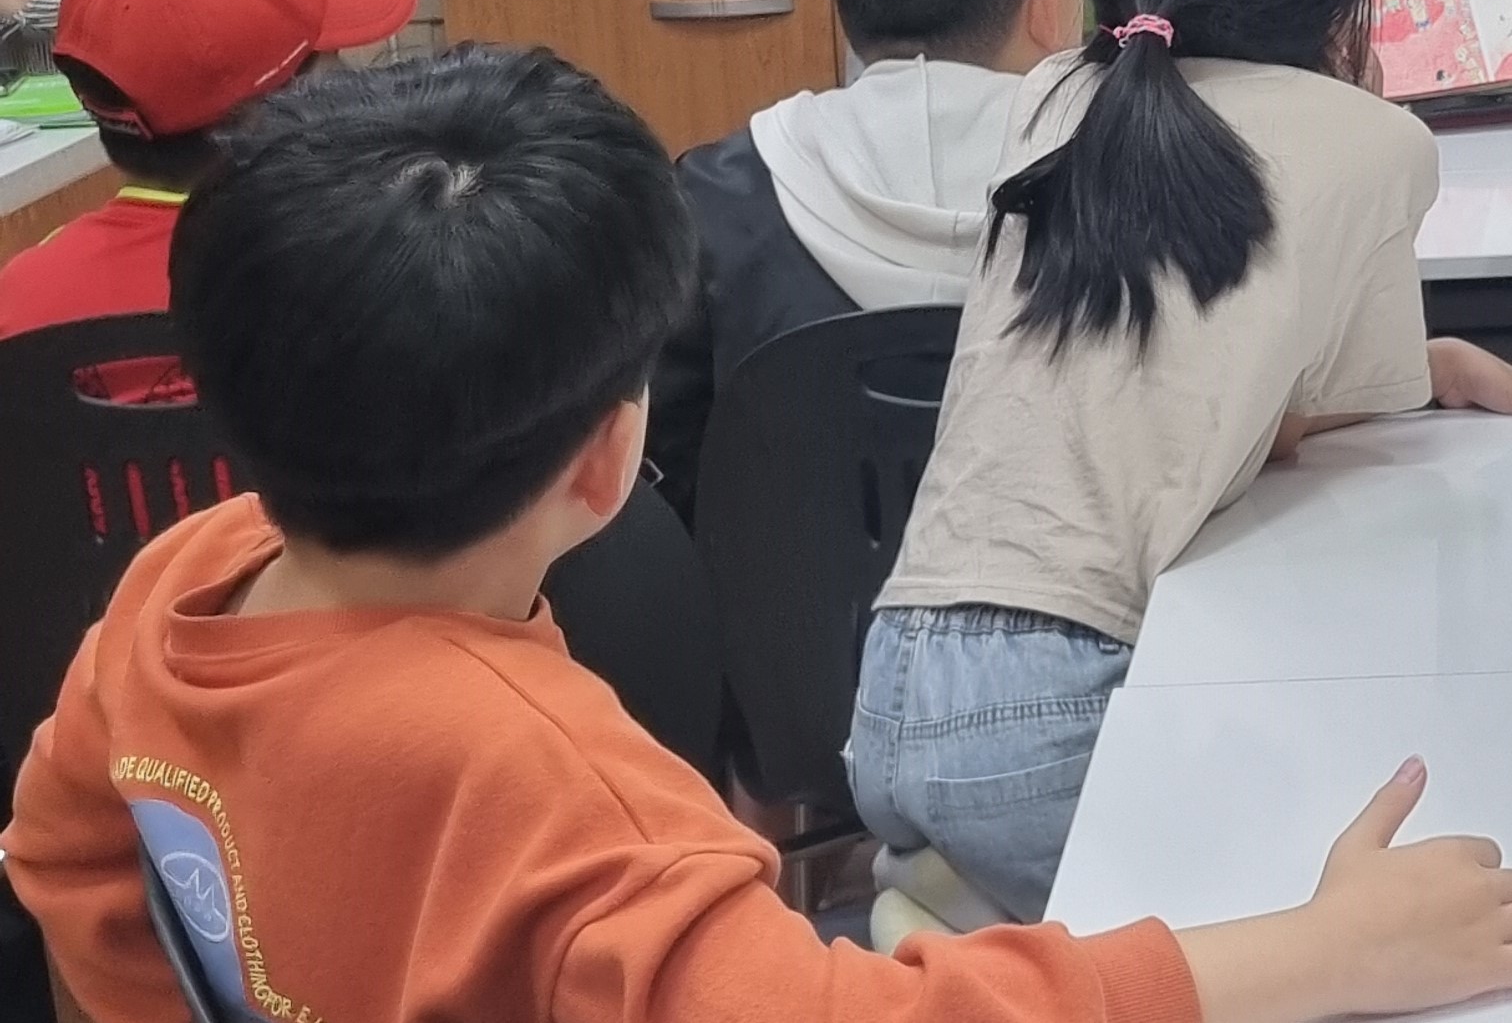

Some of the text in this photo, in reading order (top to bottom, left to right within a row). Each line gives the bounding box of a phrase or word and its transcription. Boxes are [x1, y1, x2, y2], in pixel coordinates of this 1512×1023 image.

[136, 757, 210, 803] QUALIFIED
[207, 790, 241, 870] PRODUCT
[232, 875, 248, 913] AND
[238, 915, 271, 1000] CLOTHING
[264, 992, 293, 1017] FOR
